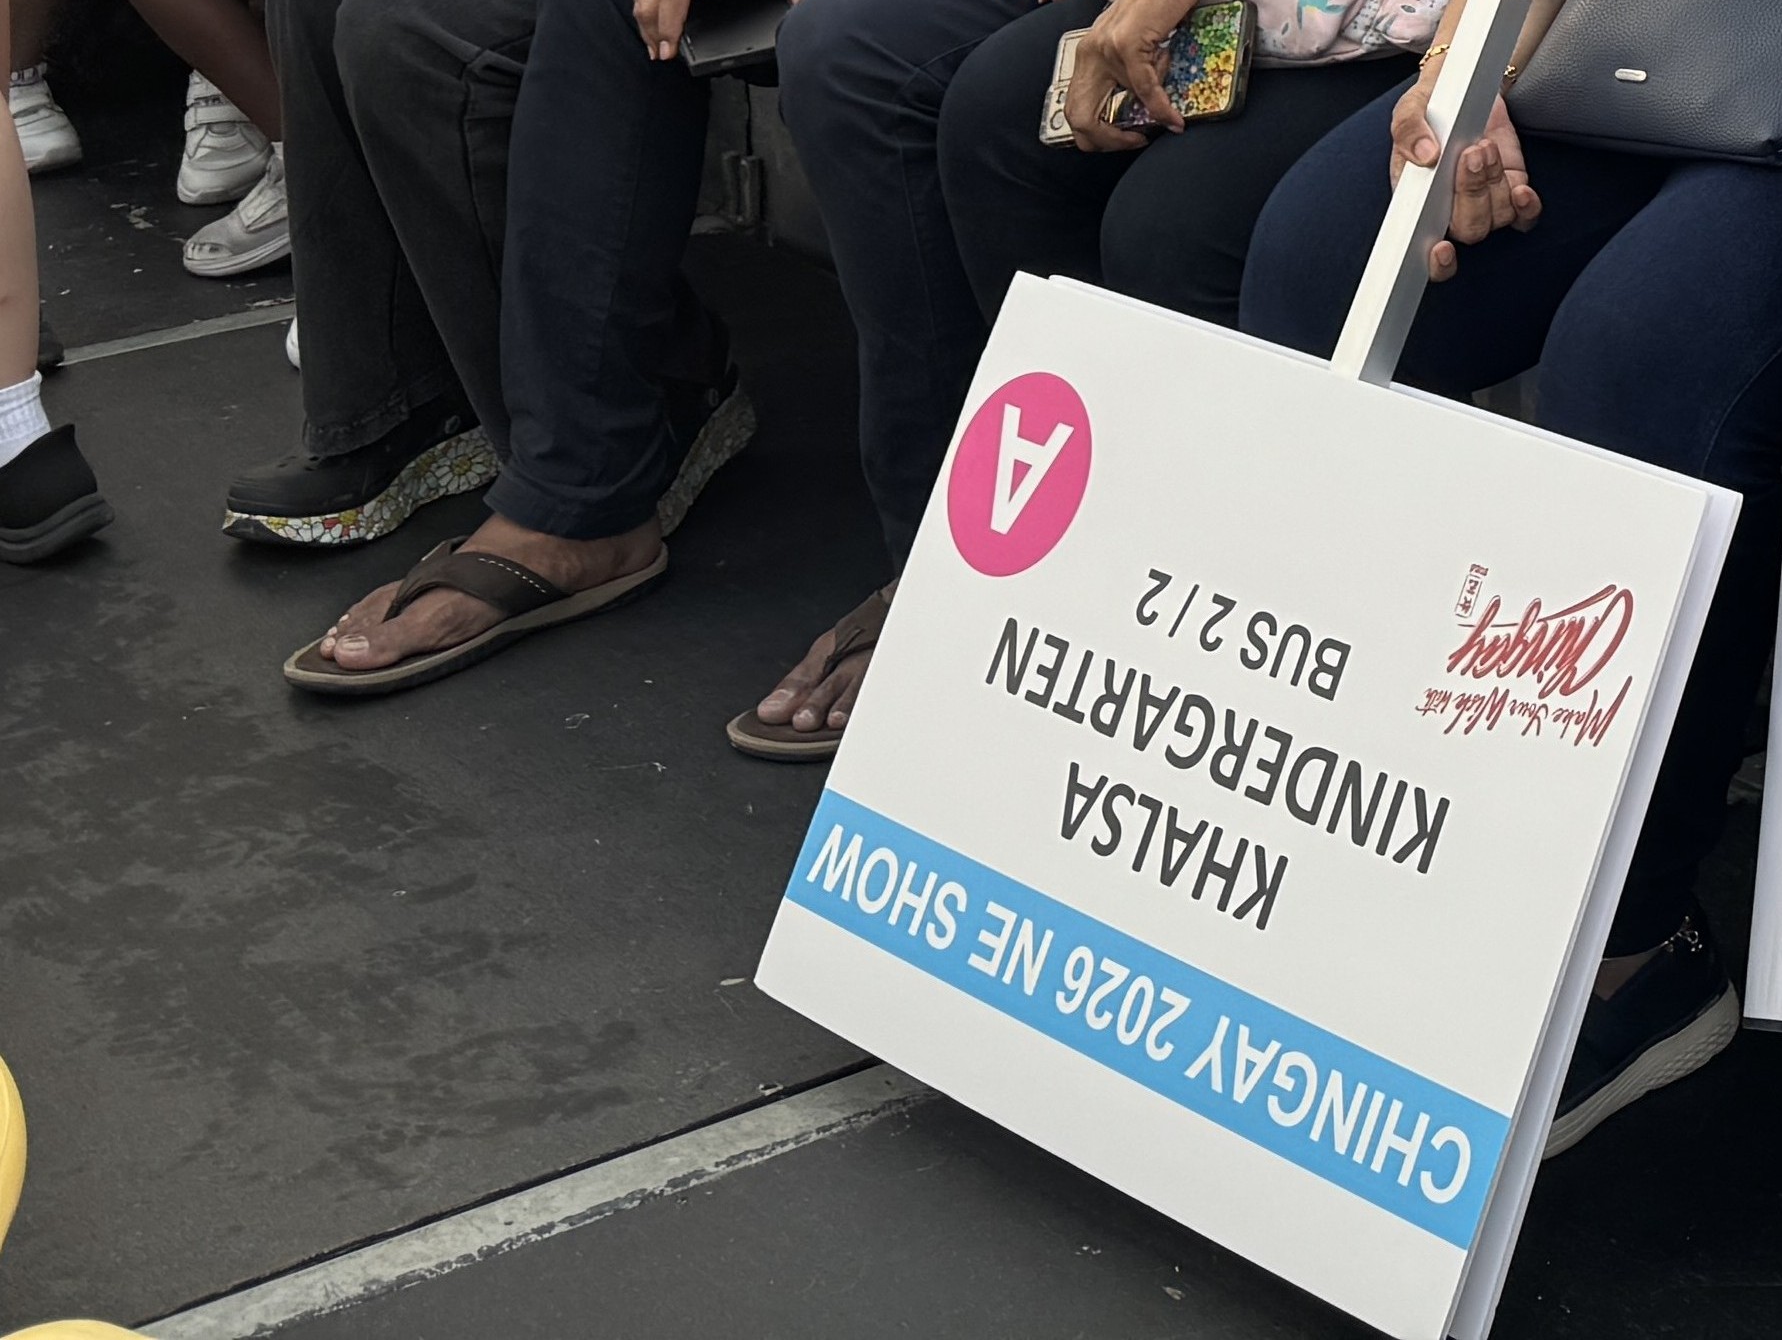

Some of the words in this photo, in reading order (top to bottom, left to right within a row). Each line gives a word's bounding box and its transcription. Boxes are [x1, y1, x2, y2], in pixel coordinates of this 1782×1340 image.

[991, 404, 1073, 534] A
[1240, 611, 1351, 701] BUS
[1446, 584, 1634, 700] Chingay
[986, 618, 1450, 874] KINDERGARTEN
[1443, 686, 1510, 735] Wish
[1508, 698, 1549, 736] Your
[1552, 675, 1633, 747] Make
[807, 825, 967, 949] SHOW
[1061, 762, 1288, 930] KHALSA
[969, 902, 1053, 995] NE
[1056, 946, 1190, 1061] 2026
[1185, 1016, 1471, 1204] CHINGAY
